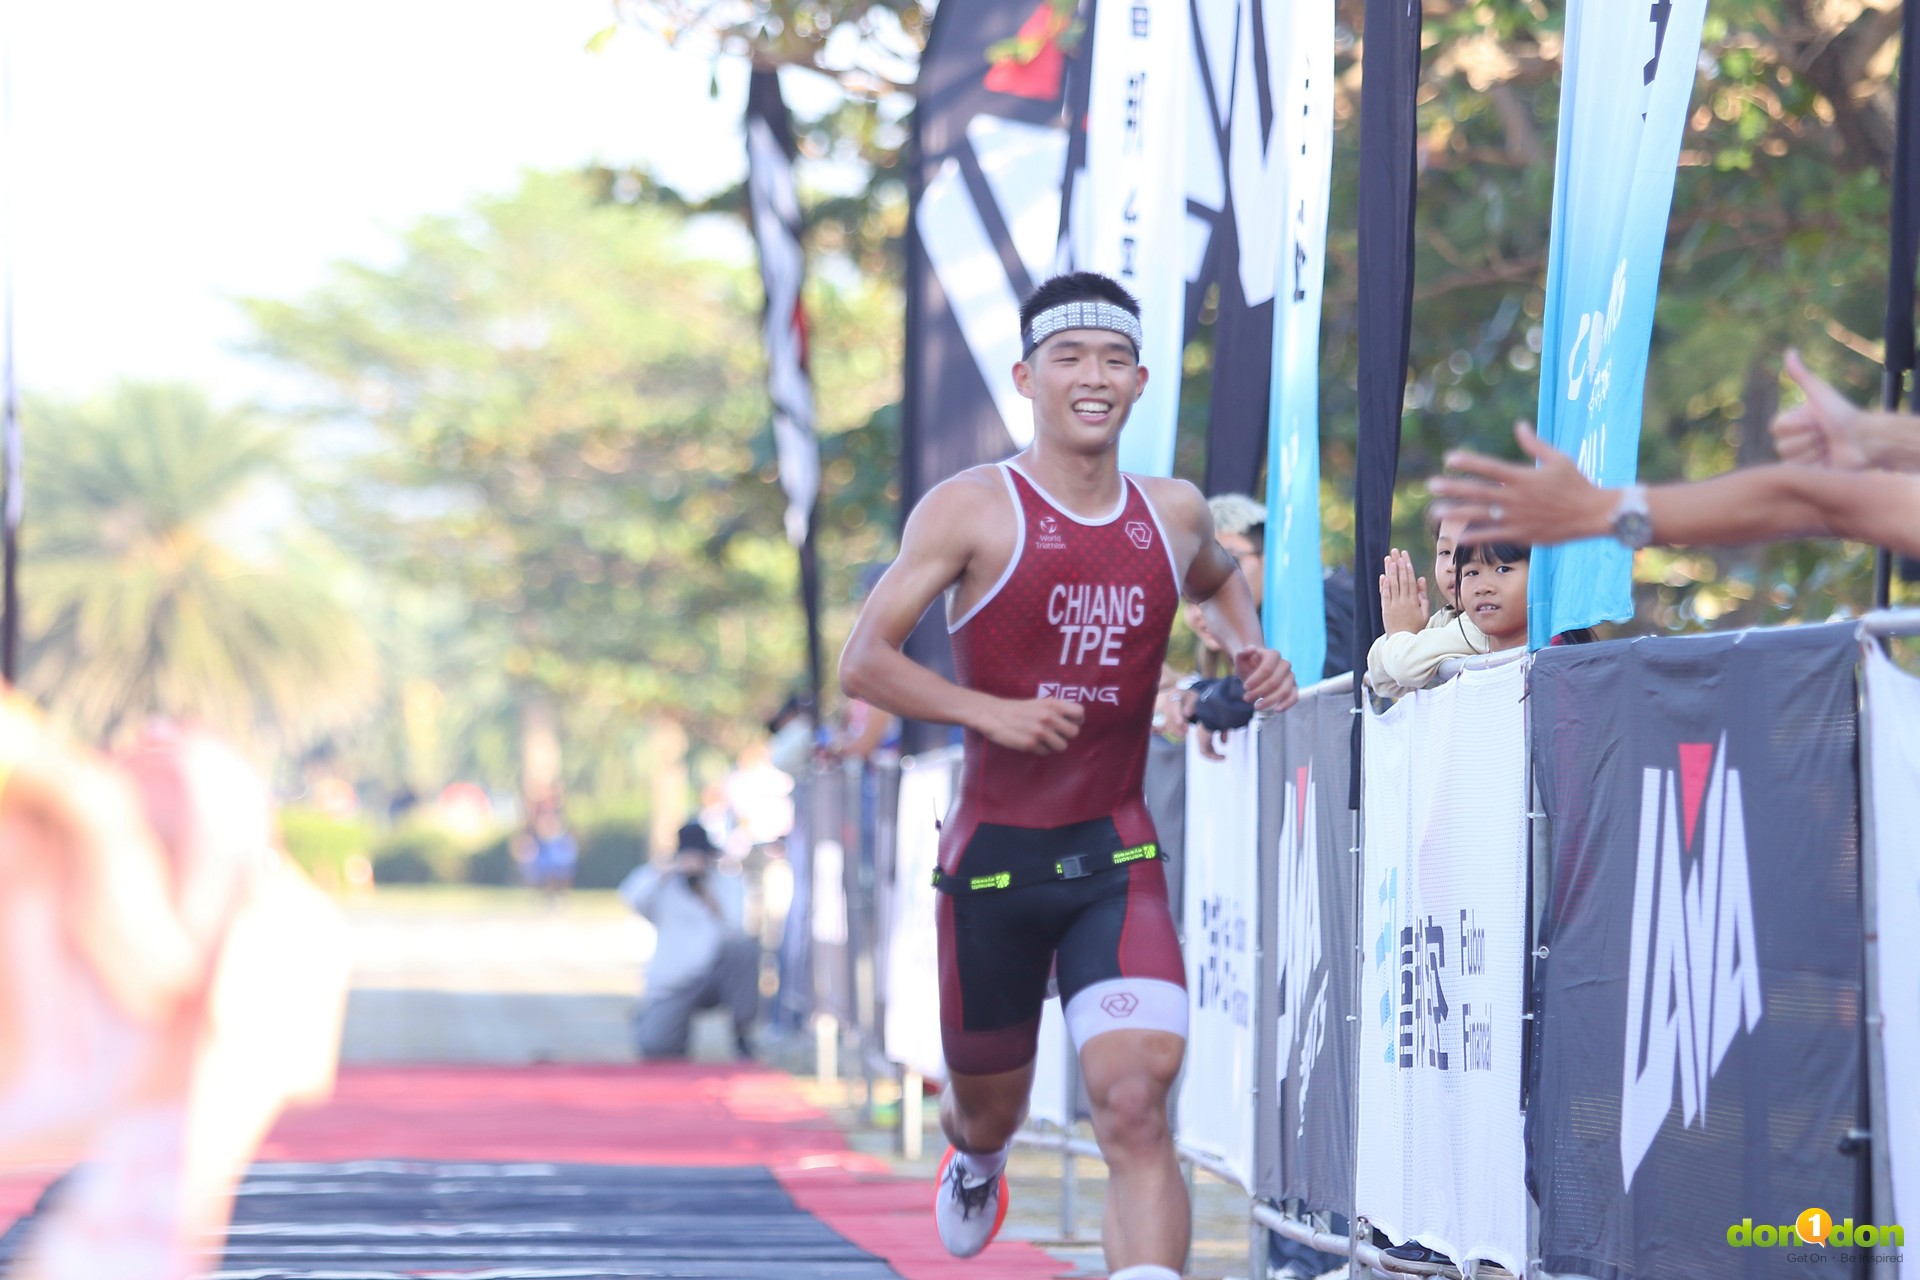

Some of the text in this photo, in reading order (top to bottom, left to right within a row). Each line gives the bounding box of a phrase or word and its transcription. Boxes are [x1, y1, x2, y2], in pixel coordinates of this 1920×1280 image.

[1035, 541, 1067, 549] Triathlon
[1048, 584, 1145, 627] CHIANG
[1059, 625, 1127, 666] TPE
[1460, 908, 1486, 976] Fubon
